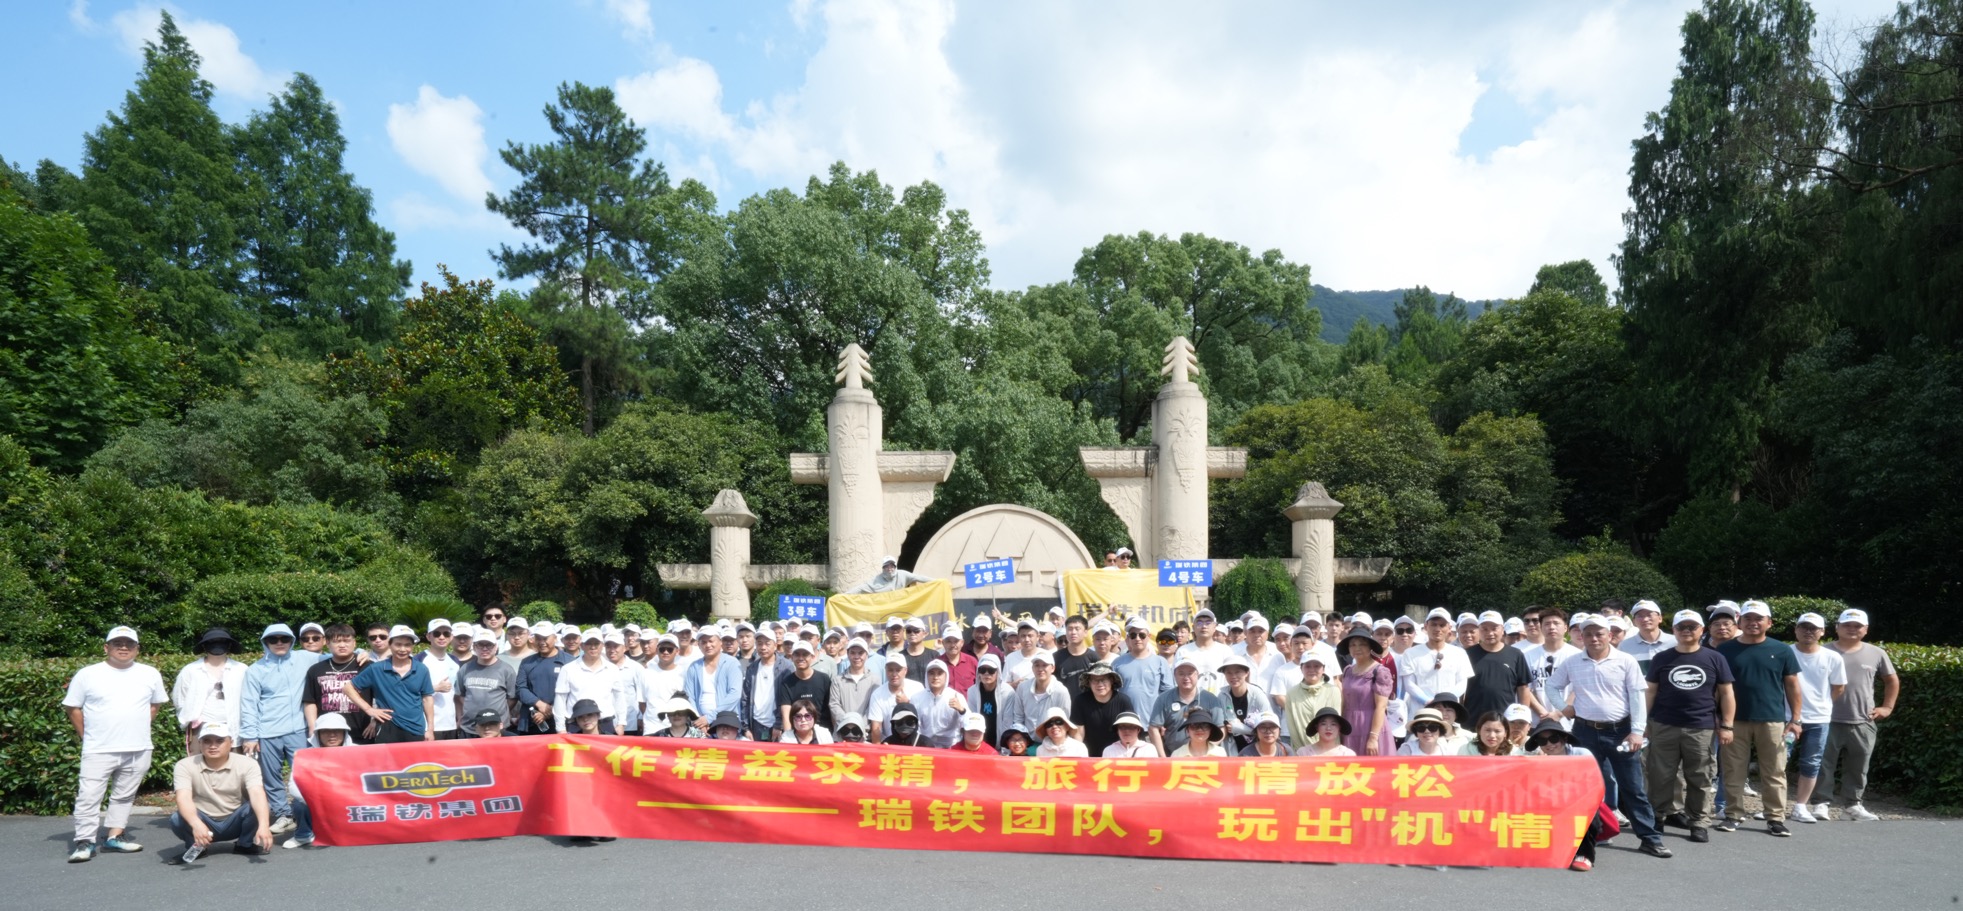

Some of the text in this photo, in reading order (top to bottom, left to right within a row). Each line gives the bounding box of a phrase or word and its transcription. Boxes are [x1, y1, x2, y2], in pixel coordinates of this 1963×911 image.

[974, 570, 1006, 584] 2号车
[1168, 571, 1204, 583] 4号车
[787, 606, 817, 617] 3号车
[346, 795, 524, 823] 瑞铁集团
